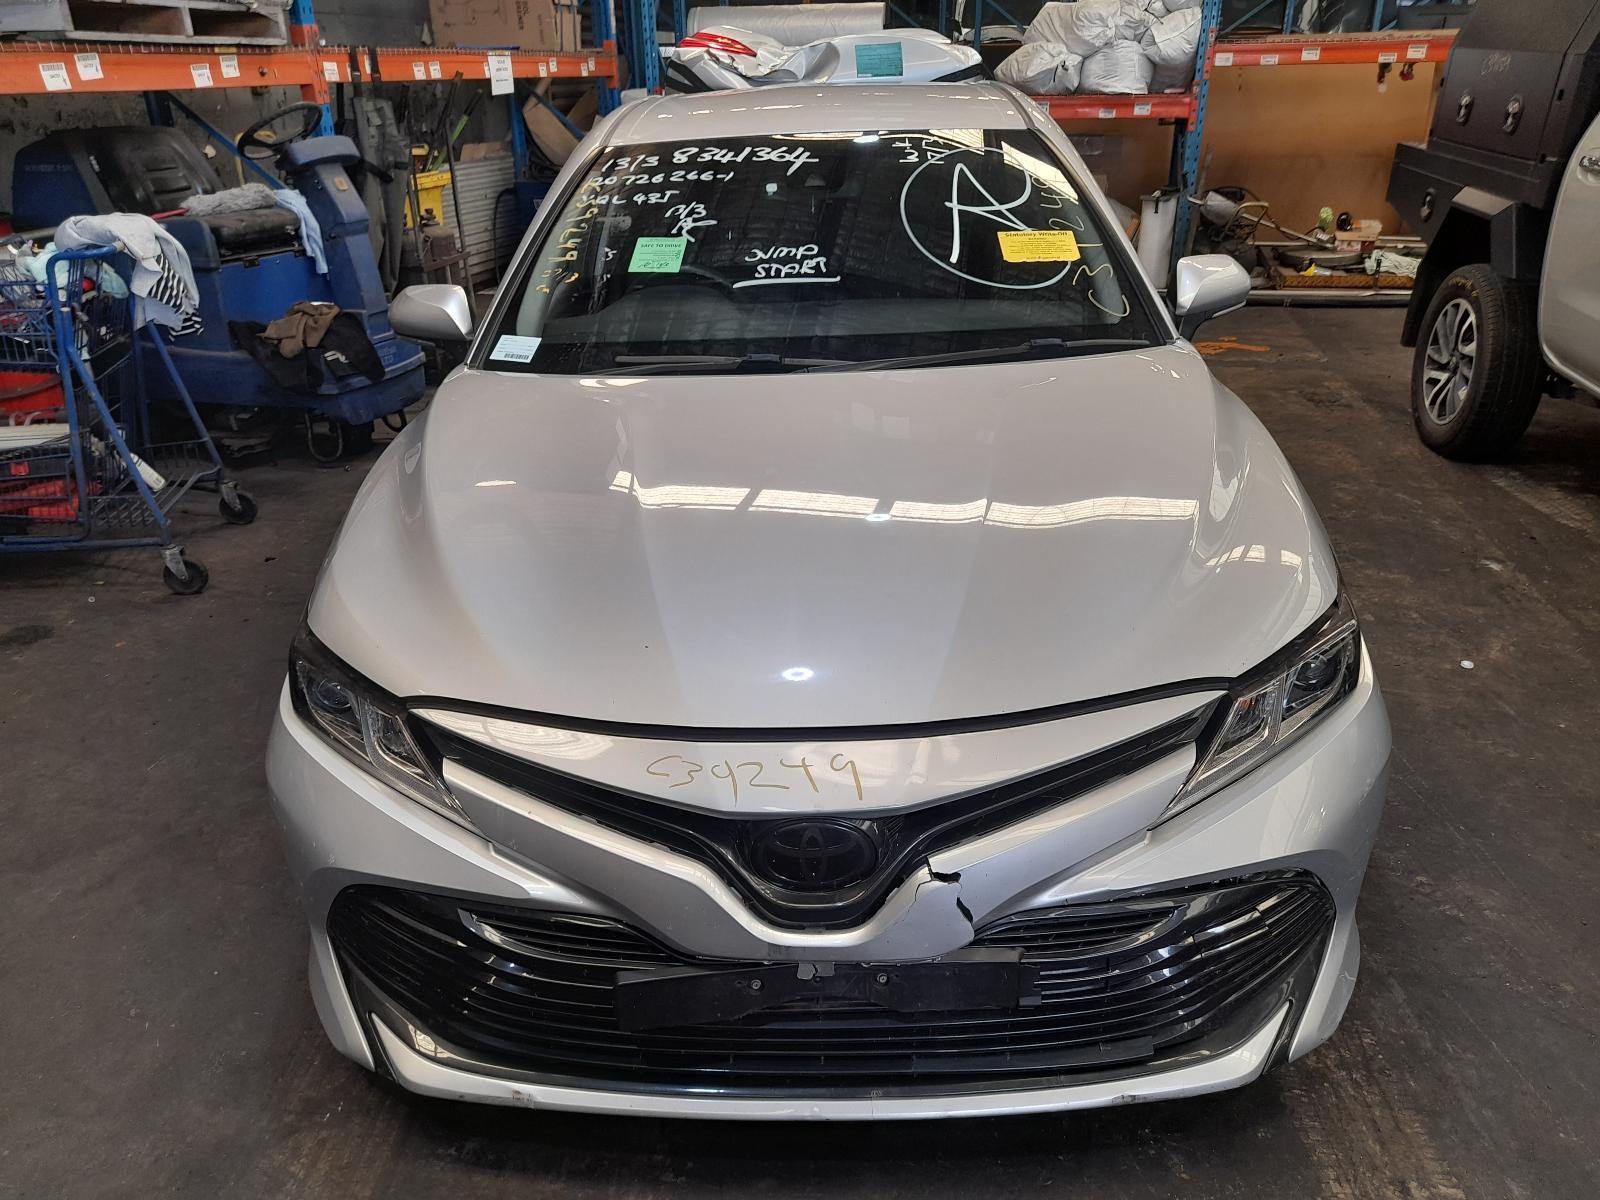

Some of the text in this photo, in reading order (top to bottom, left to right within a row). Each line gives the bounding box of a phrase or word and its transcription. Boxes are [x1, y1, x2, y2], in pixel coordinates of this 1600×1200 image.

[672, 147, 819, 176] 8341364
[744, 244, 819, 262] JUMP
[754, 257, 827, 278] START
